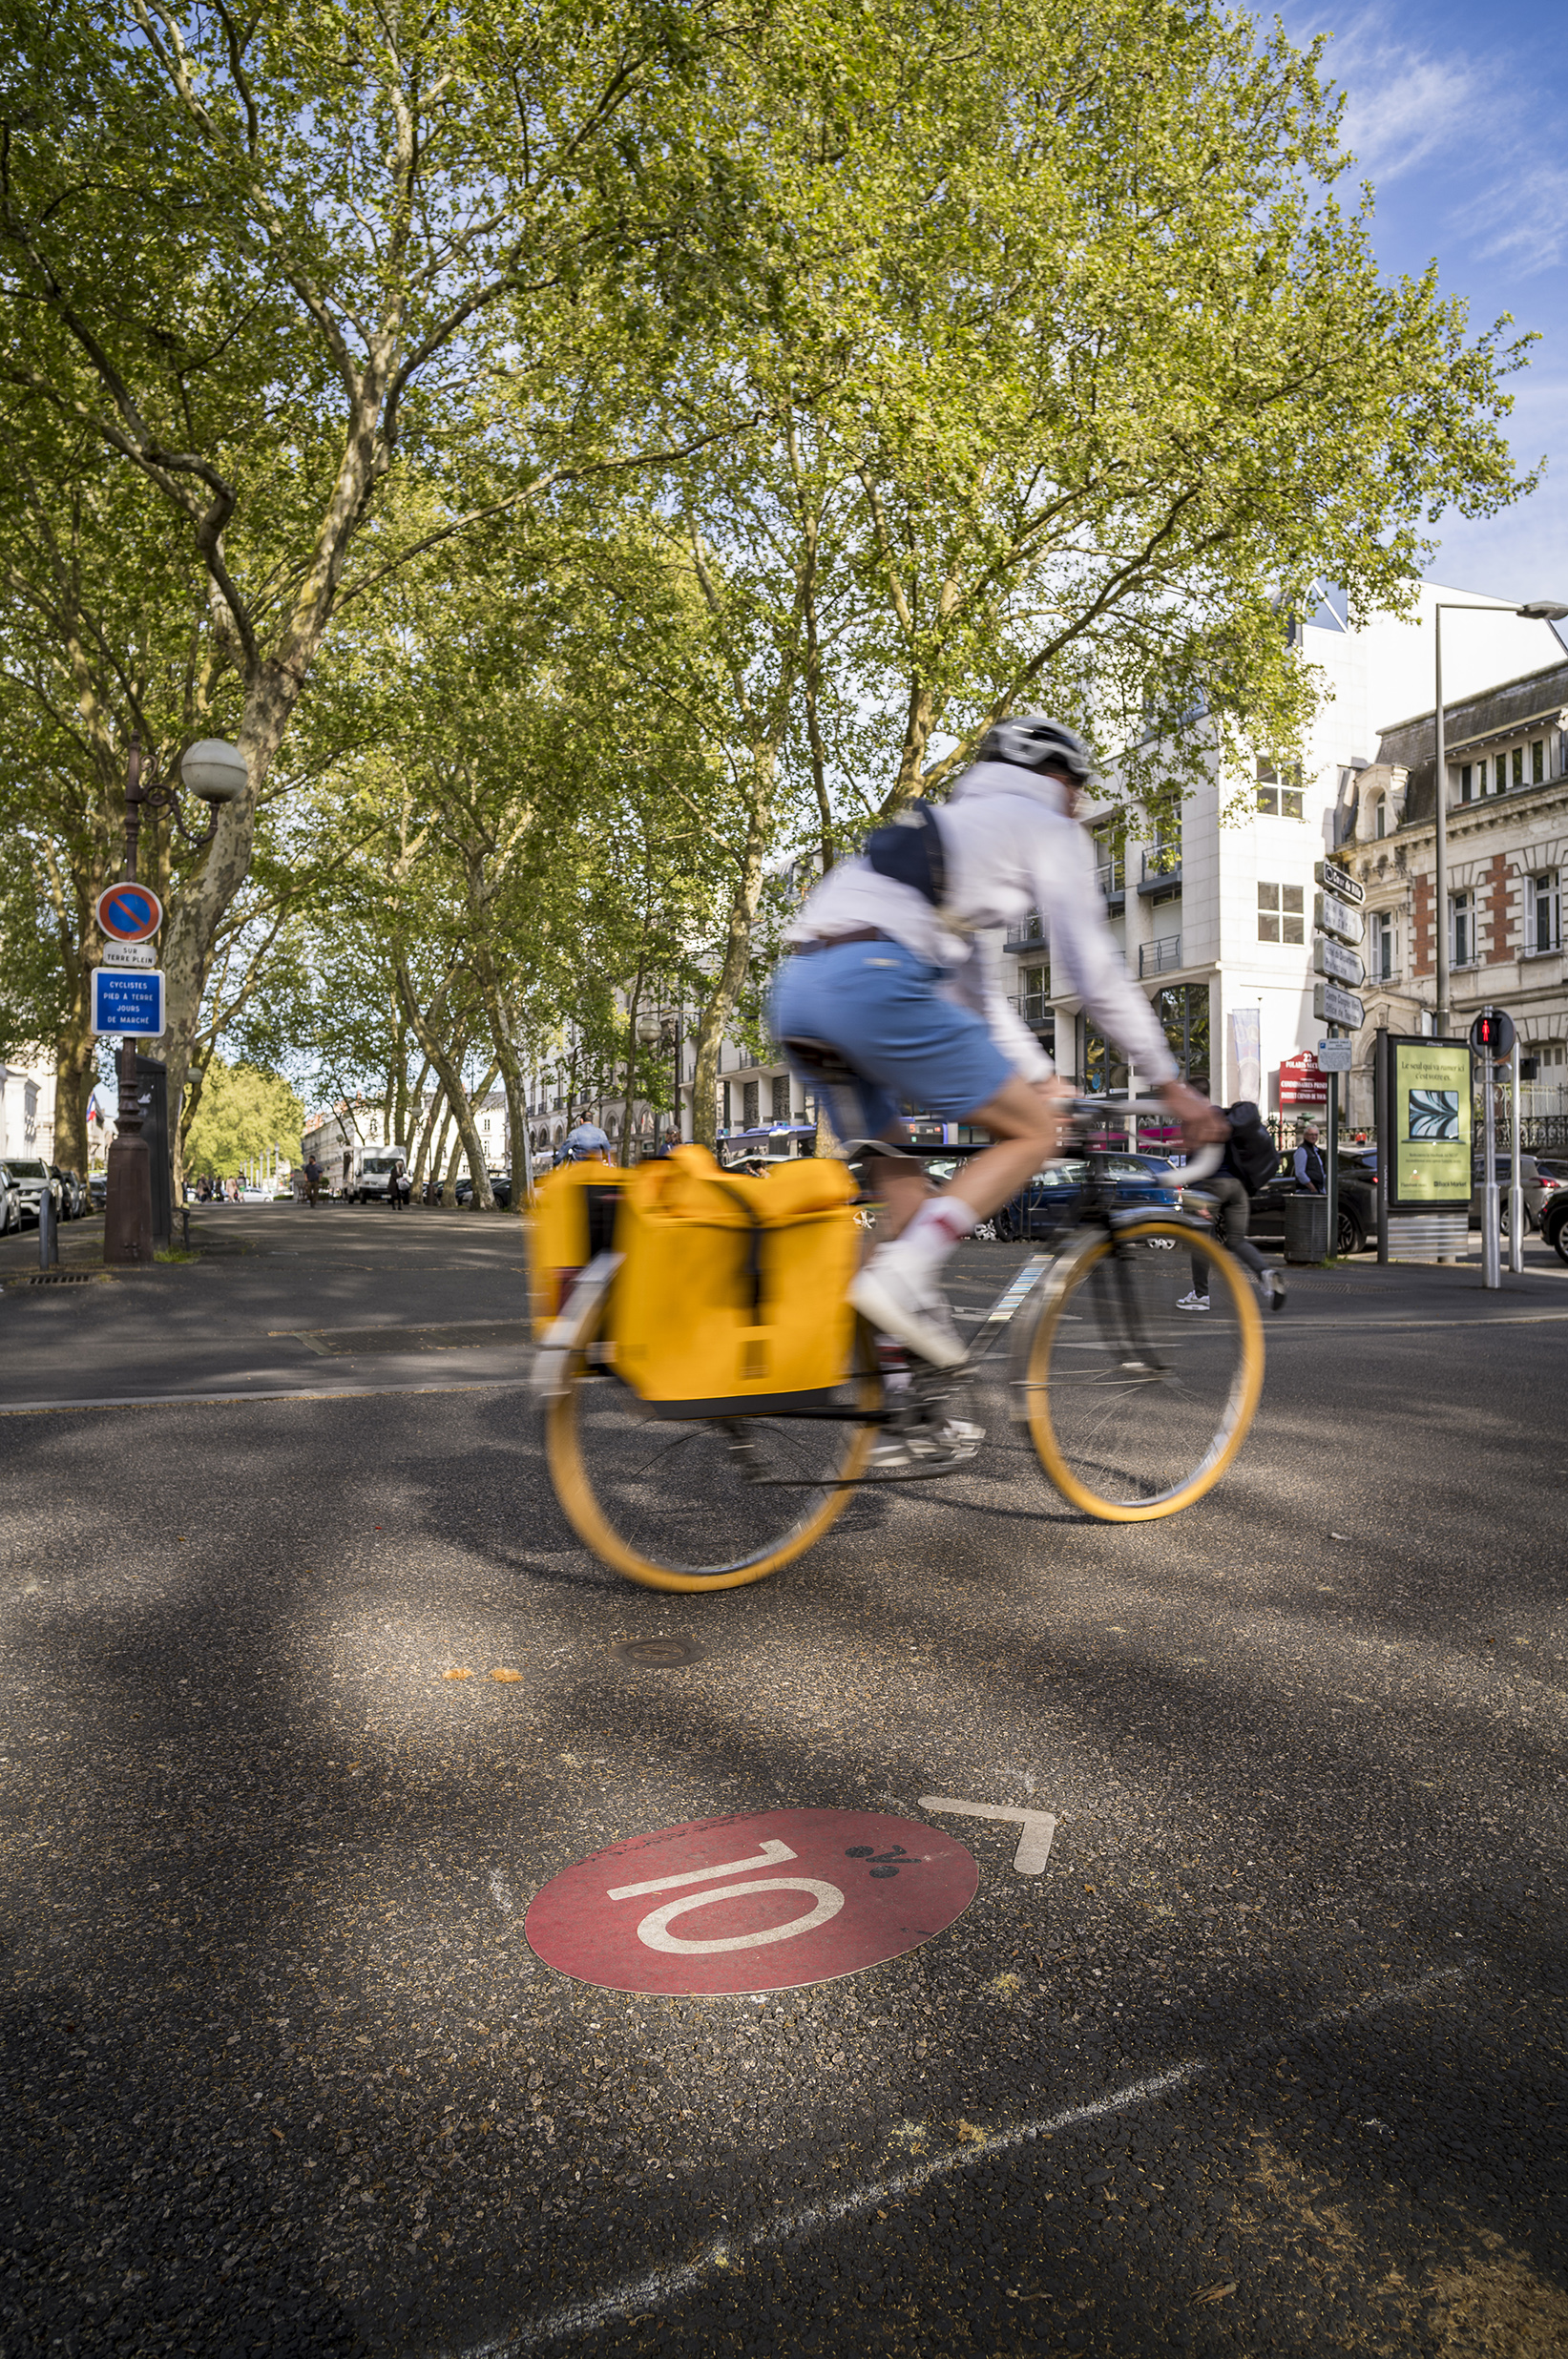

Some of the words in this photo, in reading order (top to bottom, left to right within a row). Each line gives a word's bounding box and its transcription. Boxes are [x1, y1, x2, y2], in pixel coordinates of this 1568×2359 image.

[109, 981, 147, 990] CYCLISTES
[1303, 1053, 1312, 1062] 22
[1423, 1063, 1432, 1072] qui
[607, 1839, 846, 1954] 10
